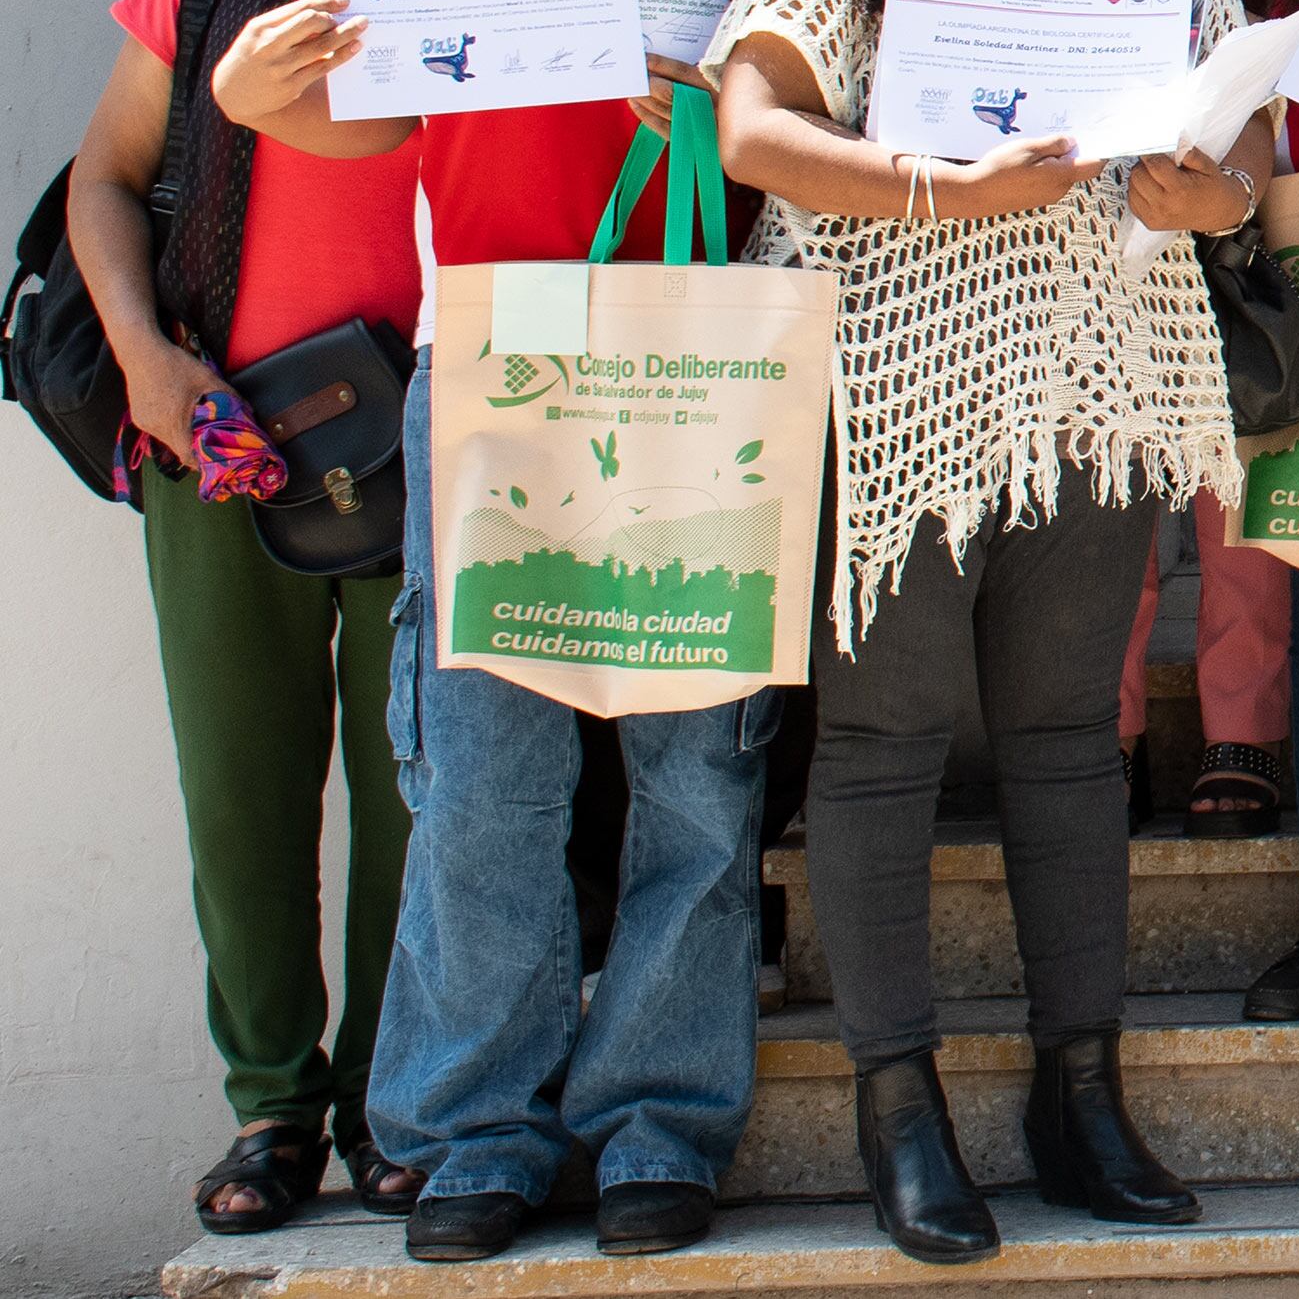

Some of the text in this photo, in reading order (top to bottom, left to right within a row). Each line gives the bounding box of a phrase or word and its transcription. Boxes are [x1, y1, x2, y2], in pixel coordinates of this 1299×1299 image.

[934, 35, 971, 46] Evelina
[973, 39, 1013, 50] Soledad
[1068, 46, 1088, 54] DNI:
[645, 353, 787, 381] Deliberante
[575, 383, 590, 396] de
[656, 385, 673, 399] de
[677, 384, 709, 402] Jujuy
[492, 600, 732, 635] cuidando la ciudad
[491, 631, 729, 665] cuidamos el futuro
